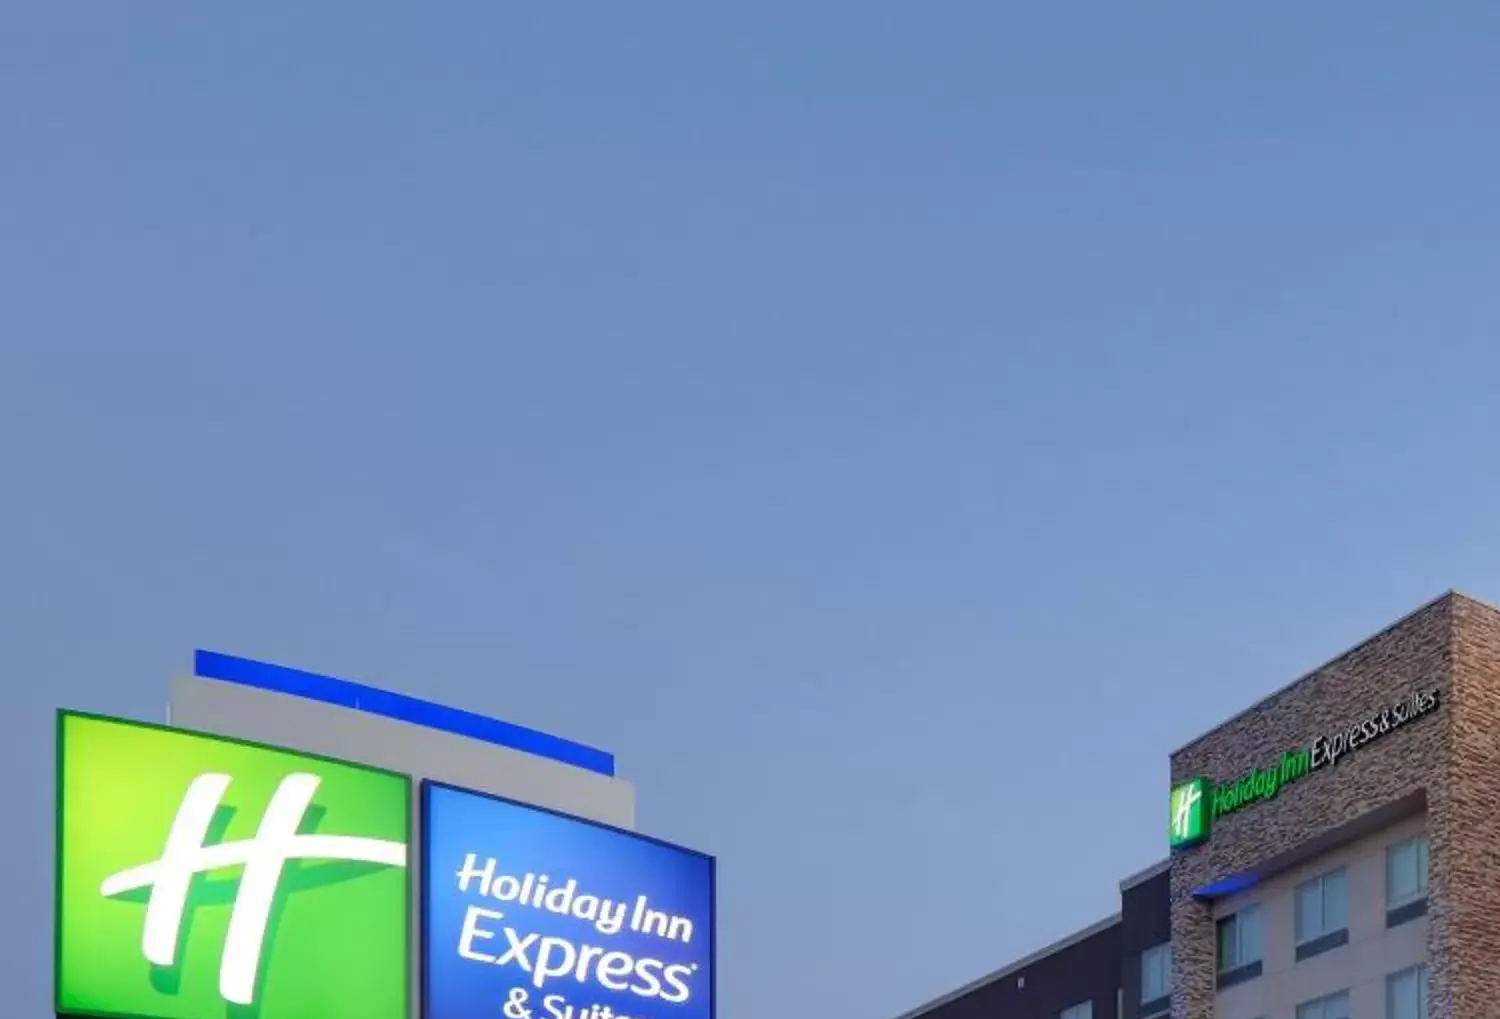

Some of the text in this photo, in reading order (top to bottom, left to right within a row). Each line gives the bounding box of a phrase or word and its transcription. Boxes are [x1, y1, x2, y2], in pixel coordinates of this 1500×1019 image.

[1212, 767, 1277, 818] Holiday
[1280, 749, 1309, 783] Inn
[1311, 714, 1379, 768] Express
[456, 853, 694, 943] Holiday Inn
[457, 904, 691, 1003] Express
